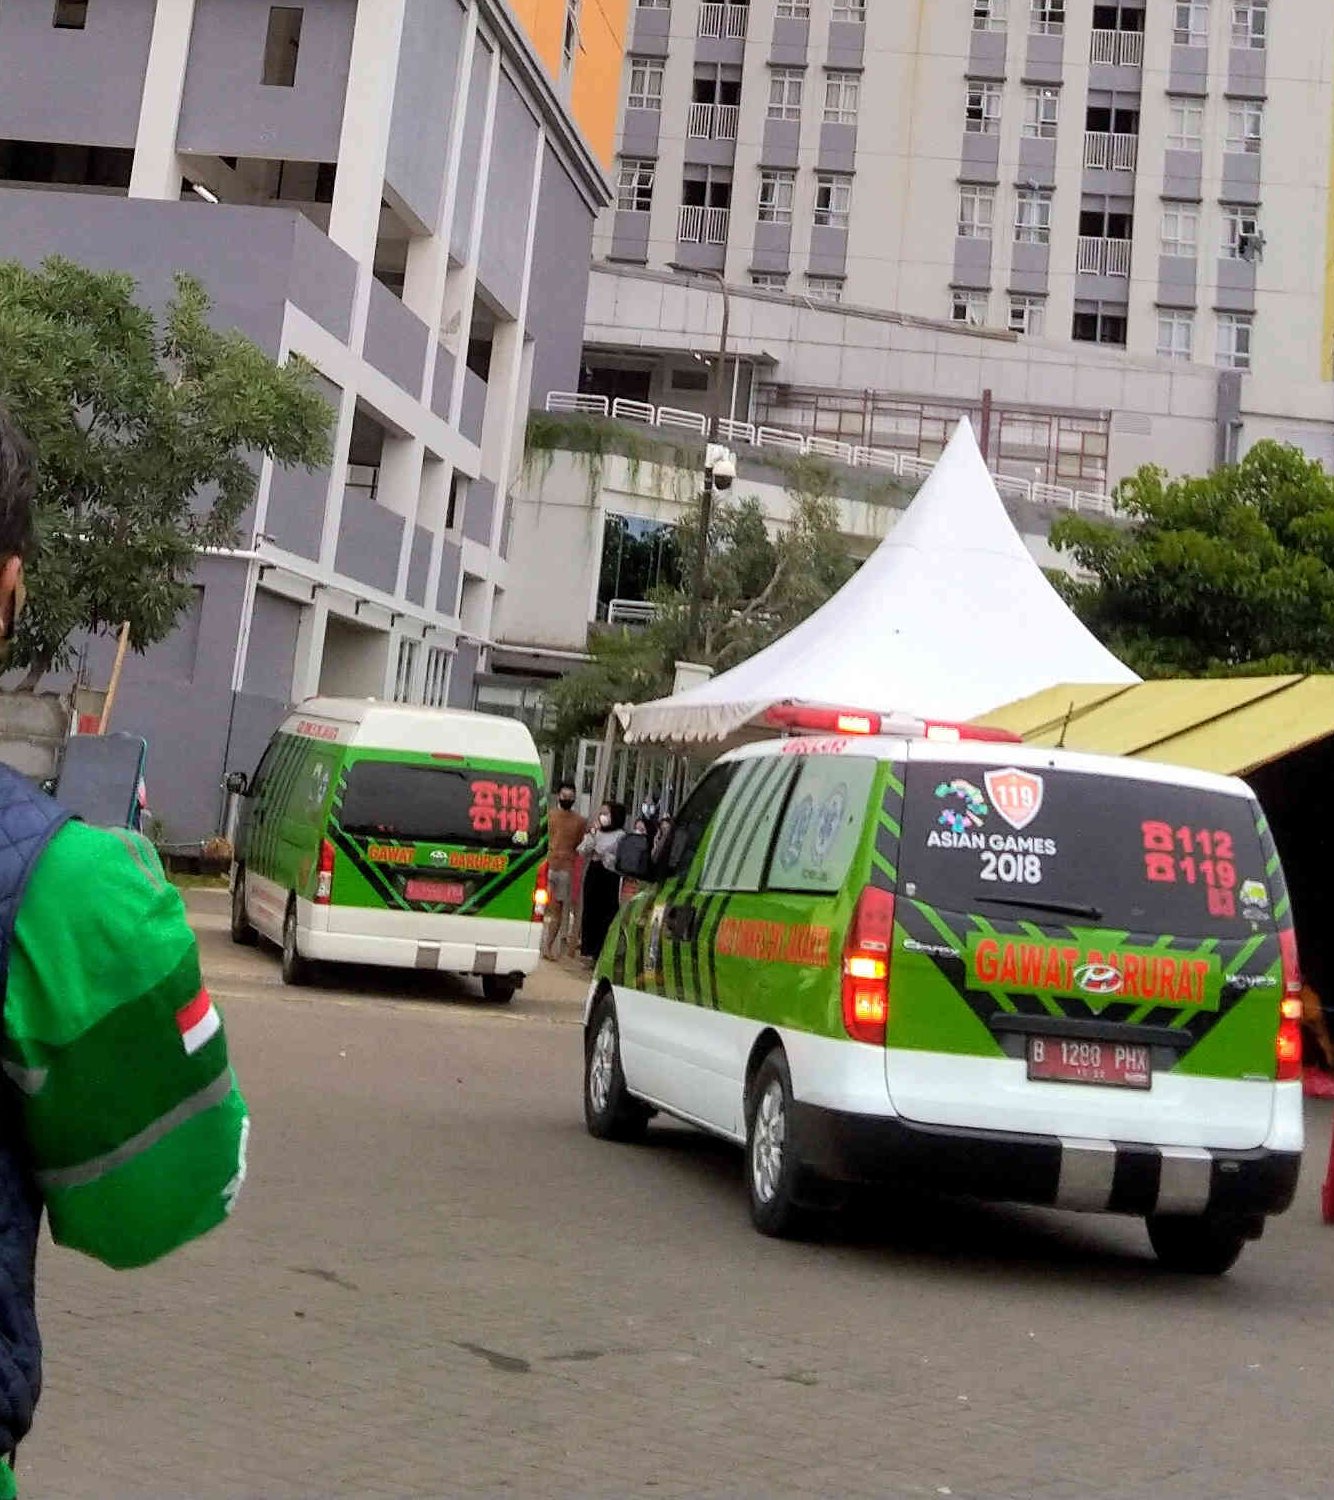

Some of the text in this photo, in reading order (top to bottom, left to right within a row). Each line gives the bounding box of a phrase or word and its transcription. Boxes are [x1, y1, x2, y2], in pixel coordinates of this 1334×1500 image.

[497, 784, 530, 810] 112
[996, 785, 1033, 806] 119
[497, 808, 530, 832] 119
[368, 843, 414, 864] GAWAT
[927, 830, 1057, 855] ASIAN GAMES
[1176, 825, 1235, 858] 112
[979, 850, 1042, 884] 2018
[1178, 855, 1237, 889] 119
[975, 938, 1079, 990] GAWAT
[1033, 1039, 1045, 1062] B
[1114, 1044, 1147, 1071] PHX
